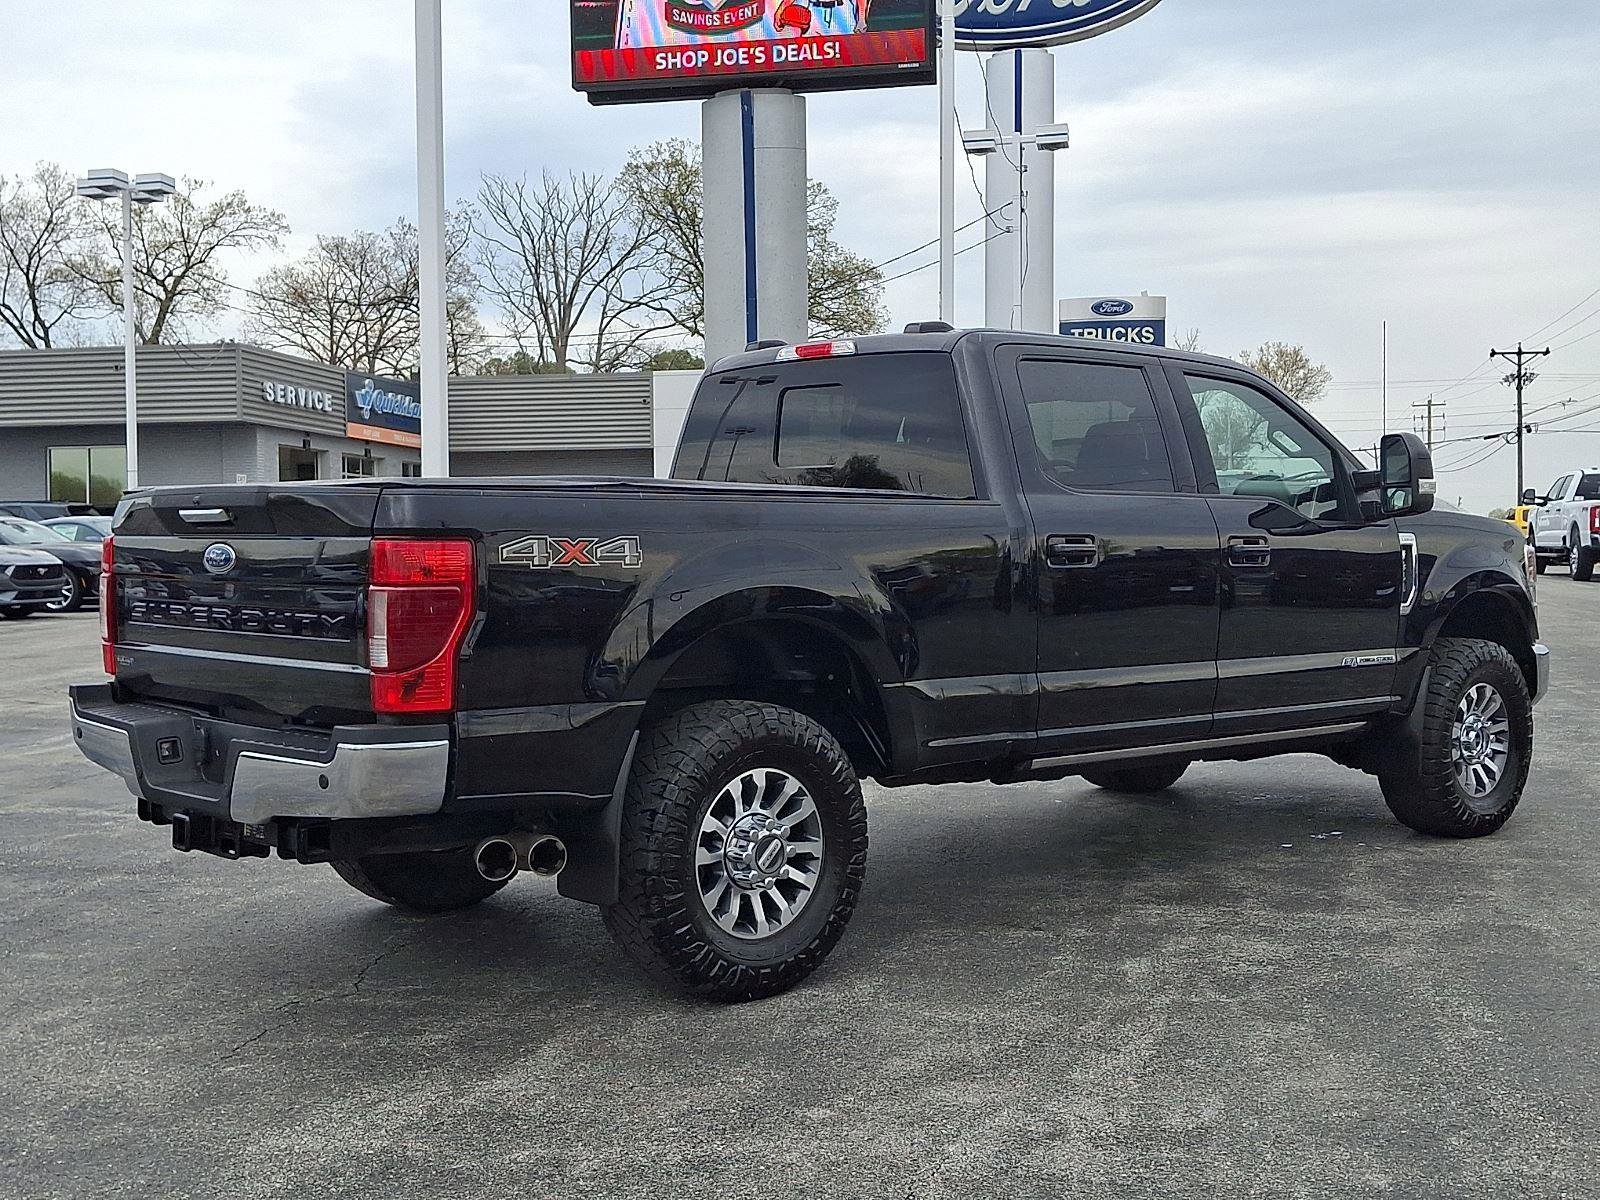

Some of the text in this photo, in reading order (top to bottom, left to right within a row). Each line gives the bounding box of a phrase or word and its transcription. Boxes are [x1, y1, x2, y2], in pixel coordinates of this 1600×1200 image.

[672, 3, 759, 26] SAVINGS EVENT
[655, 42, 841, 71] SHOP JOE'S DEALS!
[1100, 301, 1126, 313] Ford
[1070, 326, 1155, 343] TRUCKS
[263, 381, 333, 412] SERVICE
[373, 388, 421, 419] QuickLa
[130, 601, 346, 636] SUPER DUTY
